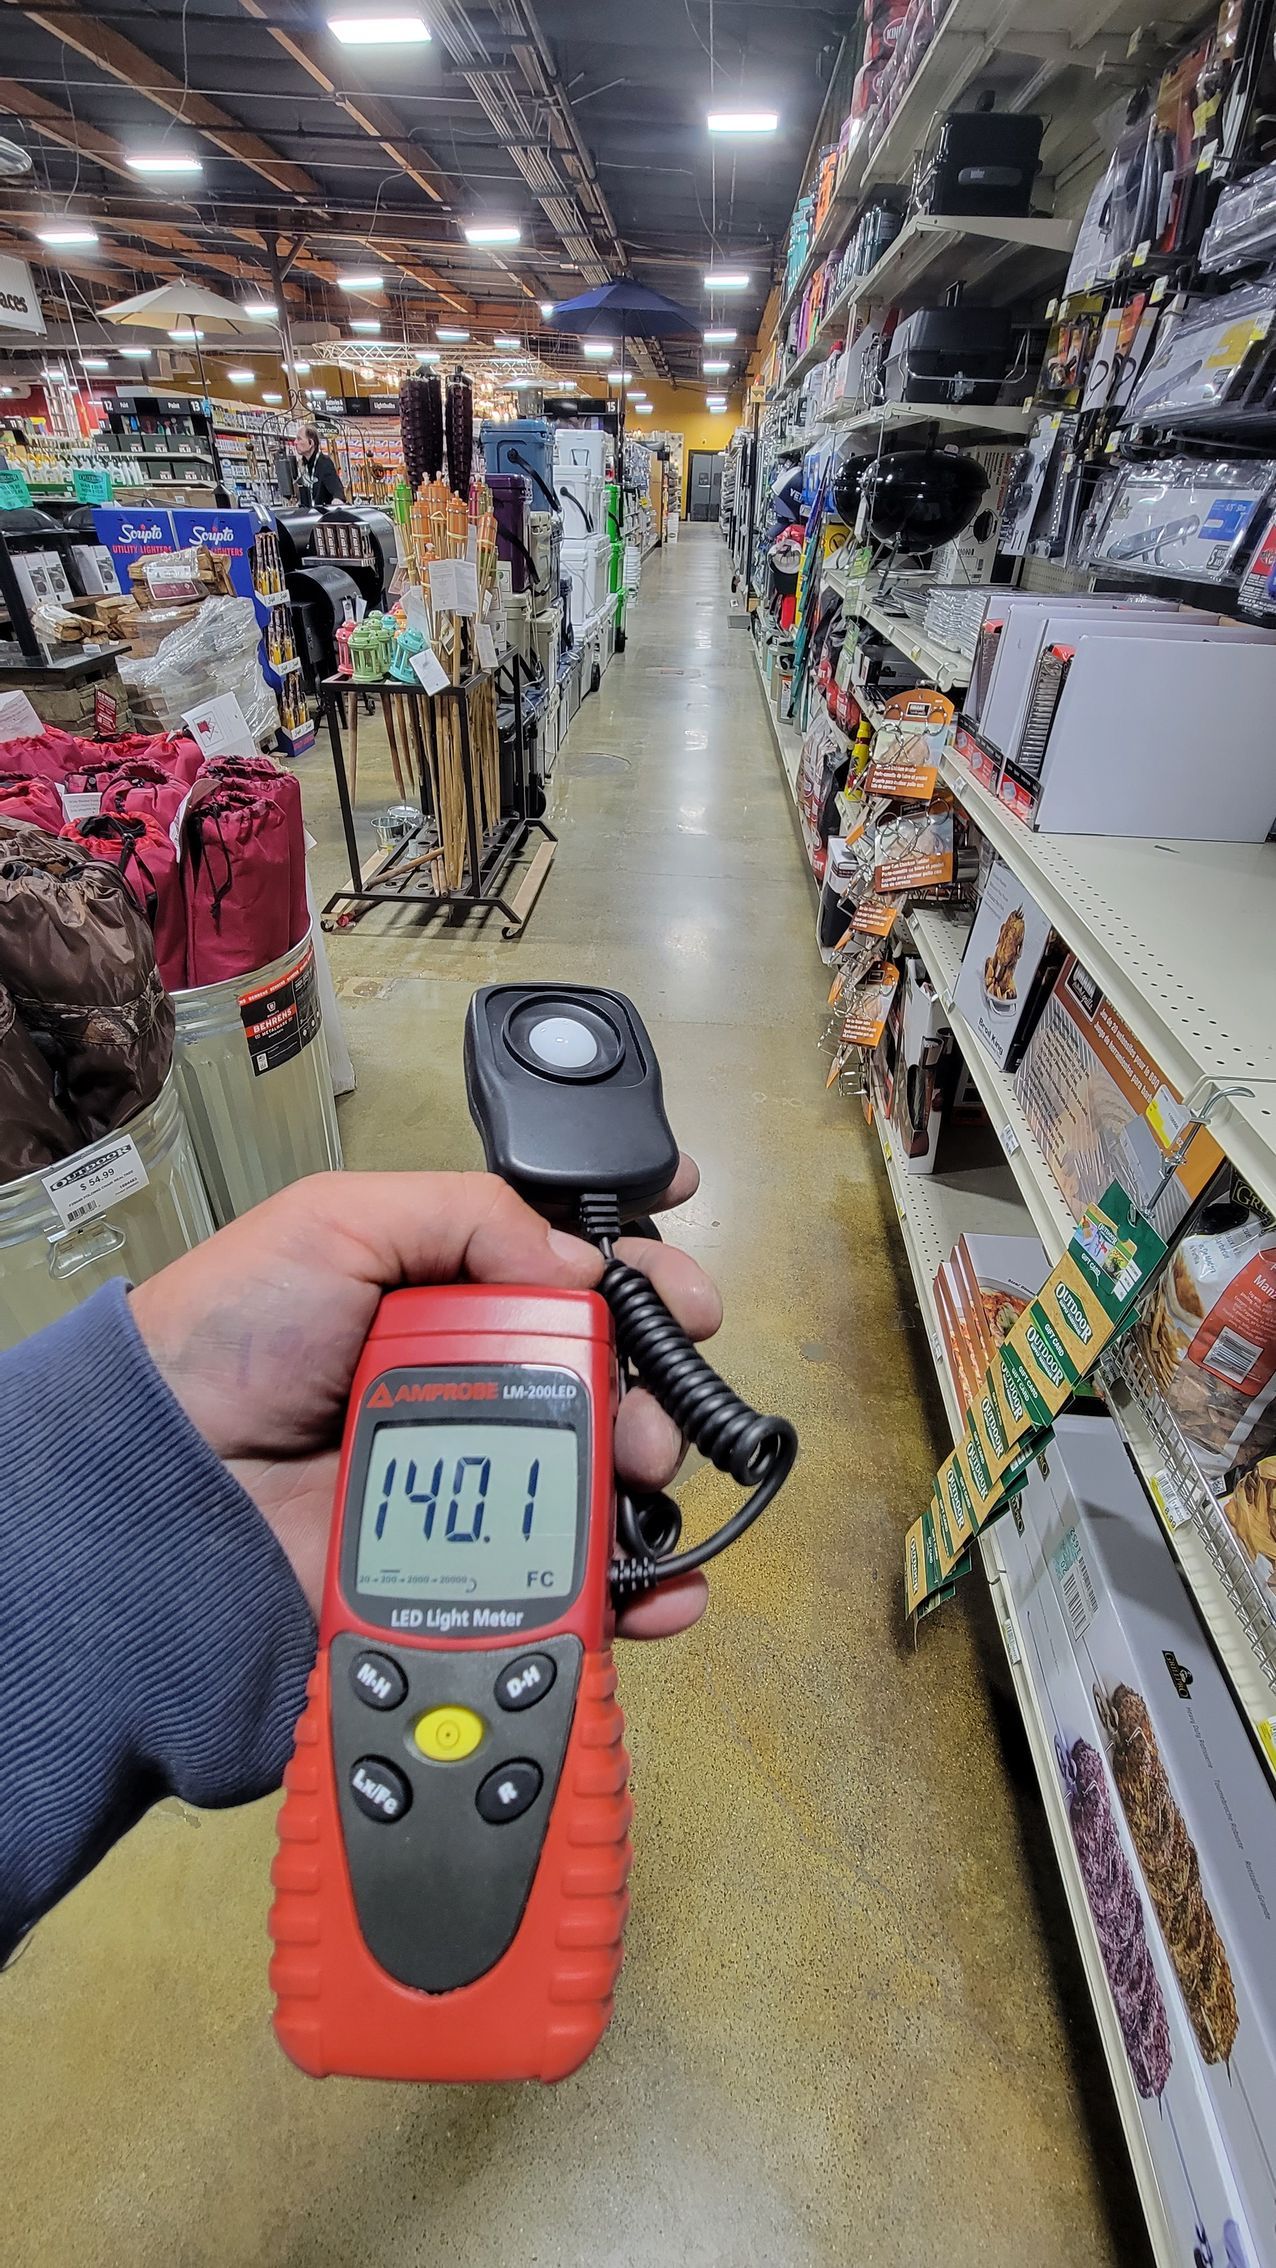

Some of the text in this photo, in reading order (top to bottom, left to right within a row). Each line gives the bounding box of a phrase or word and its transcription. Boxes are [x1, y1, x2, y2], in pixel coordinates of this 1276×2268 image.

[104, 401, 114, 411] 12
[191, 401, 200, 411] 13
[607, 401, 616, 412] 15
[112, 545, 138, 554] UTILITY
[118, 524, 162, 543] Scripto
[189, 526, 234, 545] Scripto
[253, 1008, 292, 1034] BEHRENS
[978, 1017, 991, 1039] Broil
[991, 1034, 1004, 1056] King
[51, 1145, 131, 1191] OUTDOOR
[80, 1183, 87, 1191] $
[89, 1168, 115, 1187] 54.99
[1098, 1223, 1118, 1246] OUTDOOR
[1081, 1253, 1092, 1266] GIFT
[1055, 1283, 1092, 1344] OUTDOOR
[1045, 1323, 1064, 1356] GIFT CARD
[1026, 1326, 1065, 1388] OUTDOOR
[394, 1382, 577, 1401] AMPROBE LM-200LED
[1011, 1367, 1030, 1402] GIFT CARD
[1018, 1365, 1038, 1398] GIFT CARD
[981, 1397, 1004, 1460] OUTDOOR
[966, 1441, 988, 1502] OUTDOOR
[375, 1457, 540, 1542] 140.1
[946, 1468, 965, 1531] OUTDOOR
[1164, 1508, 1177, 1529] 8.99
[527, 1571, 554, 1588] FC
[391, 1608, 524, 1631] LED Light Meter
[356, 1663, 392, 1699] M-H
[506, 1665, 541, 1698] D-H
[1164, 1653, 1190, 1698] GRILLPRO
[352, 1769, 398, 1815] Lx/Fc
